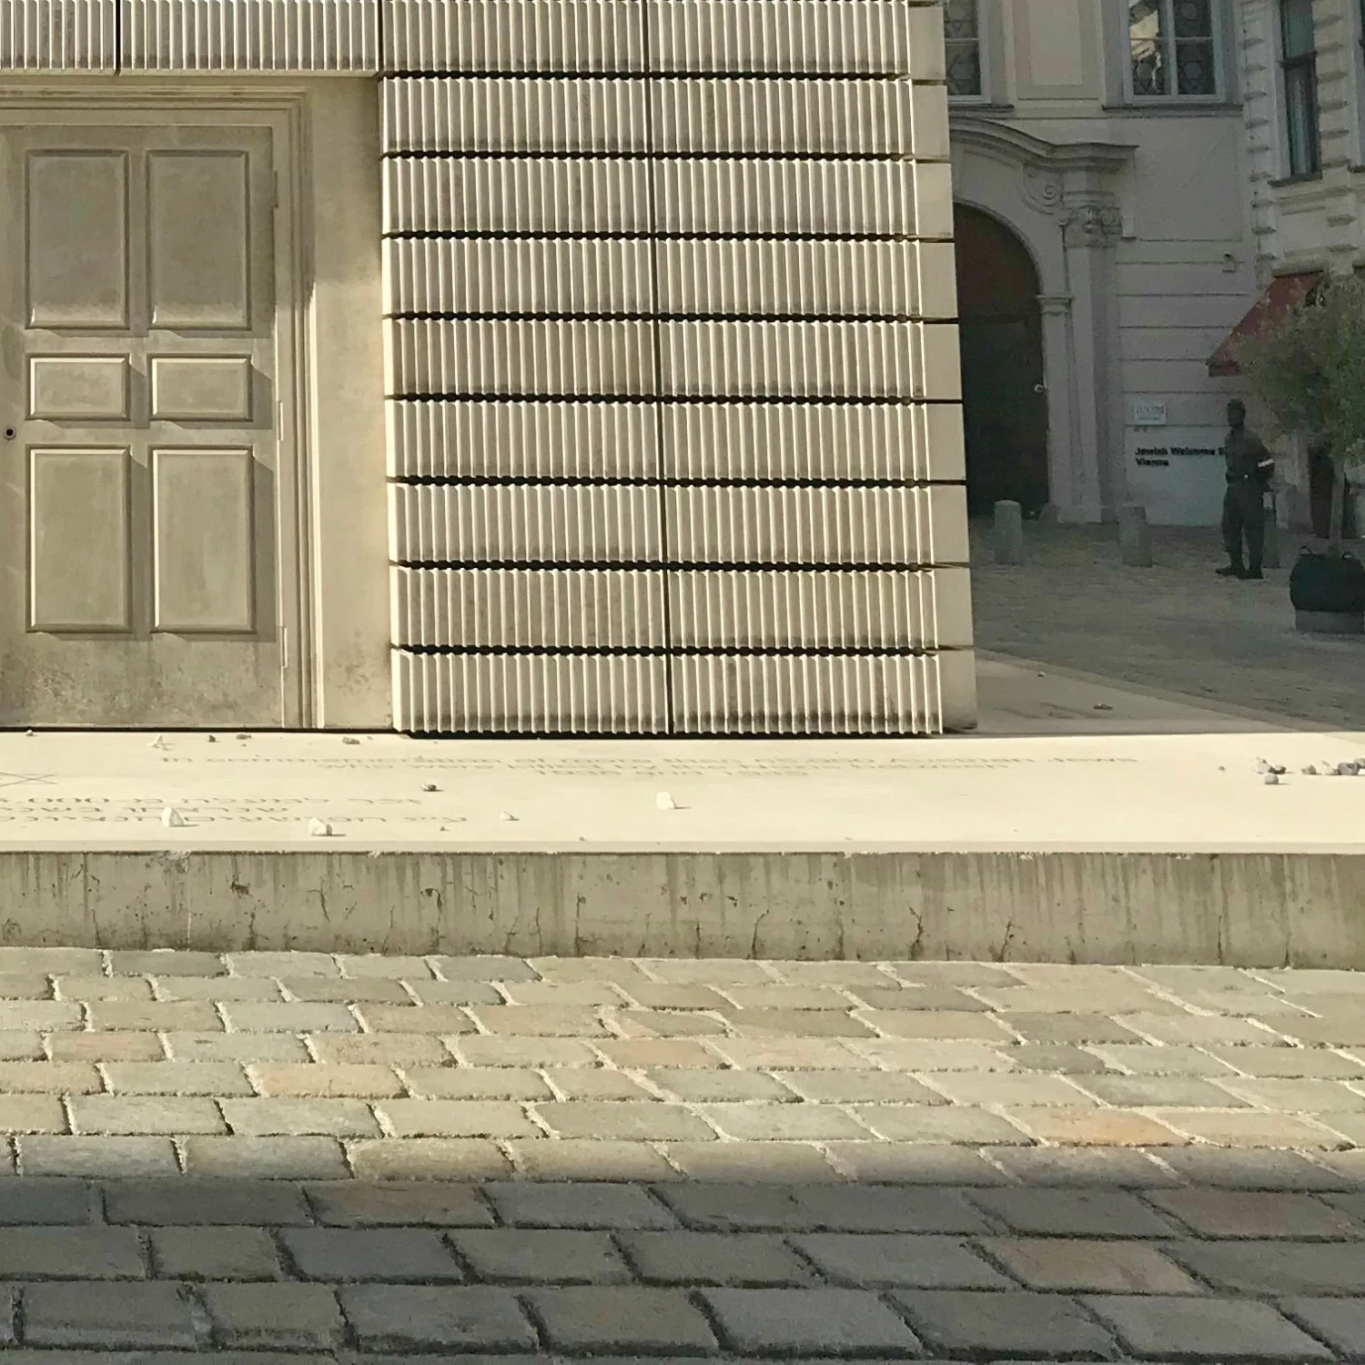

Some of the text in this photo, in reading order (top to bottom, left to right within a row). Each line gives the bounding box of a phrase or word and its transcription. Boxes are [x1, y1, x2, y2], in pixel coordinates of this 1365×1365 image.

[1135, 447, 1168, 456] Jewish
[1171, 447, 1216, 456] Welcome
[1135, 458, 1169, 466] Vienna
